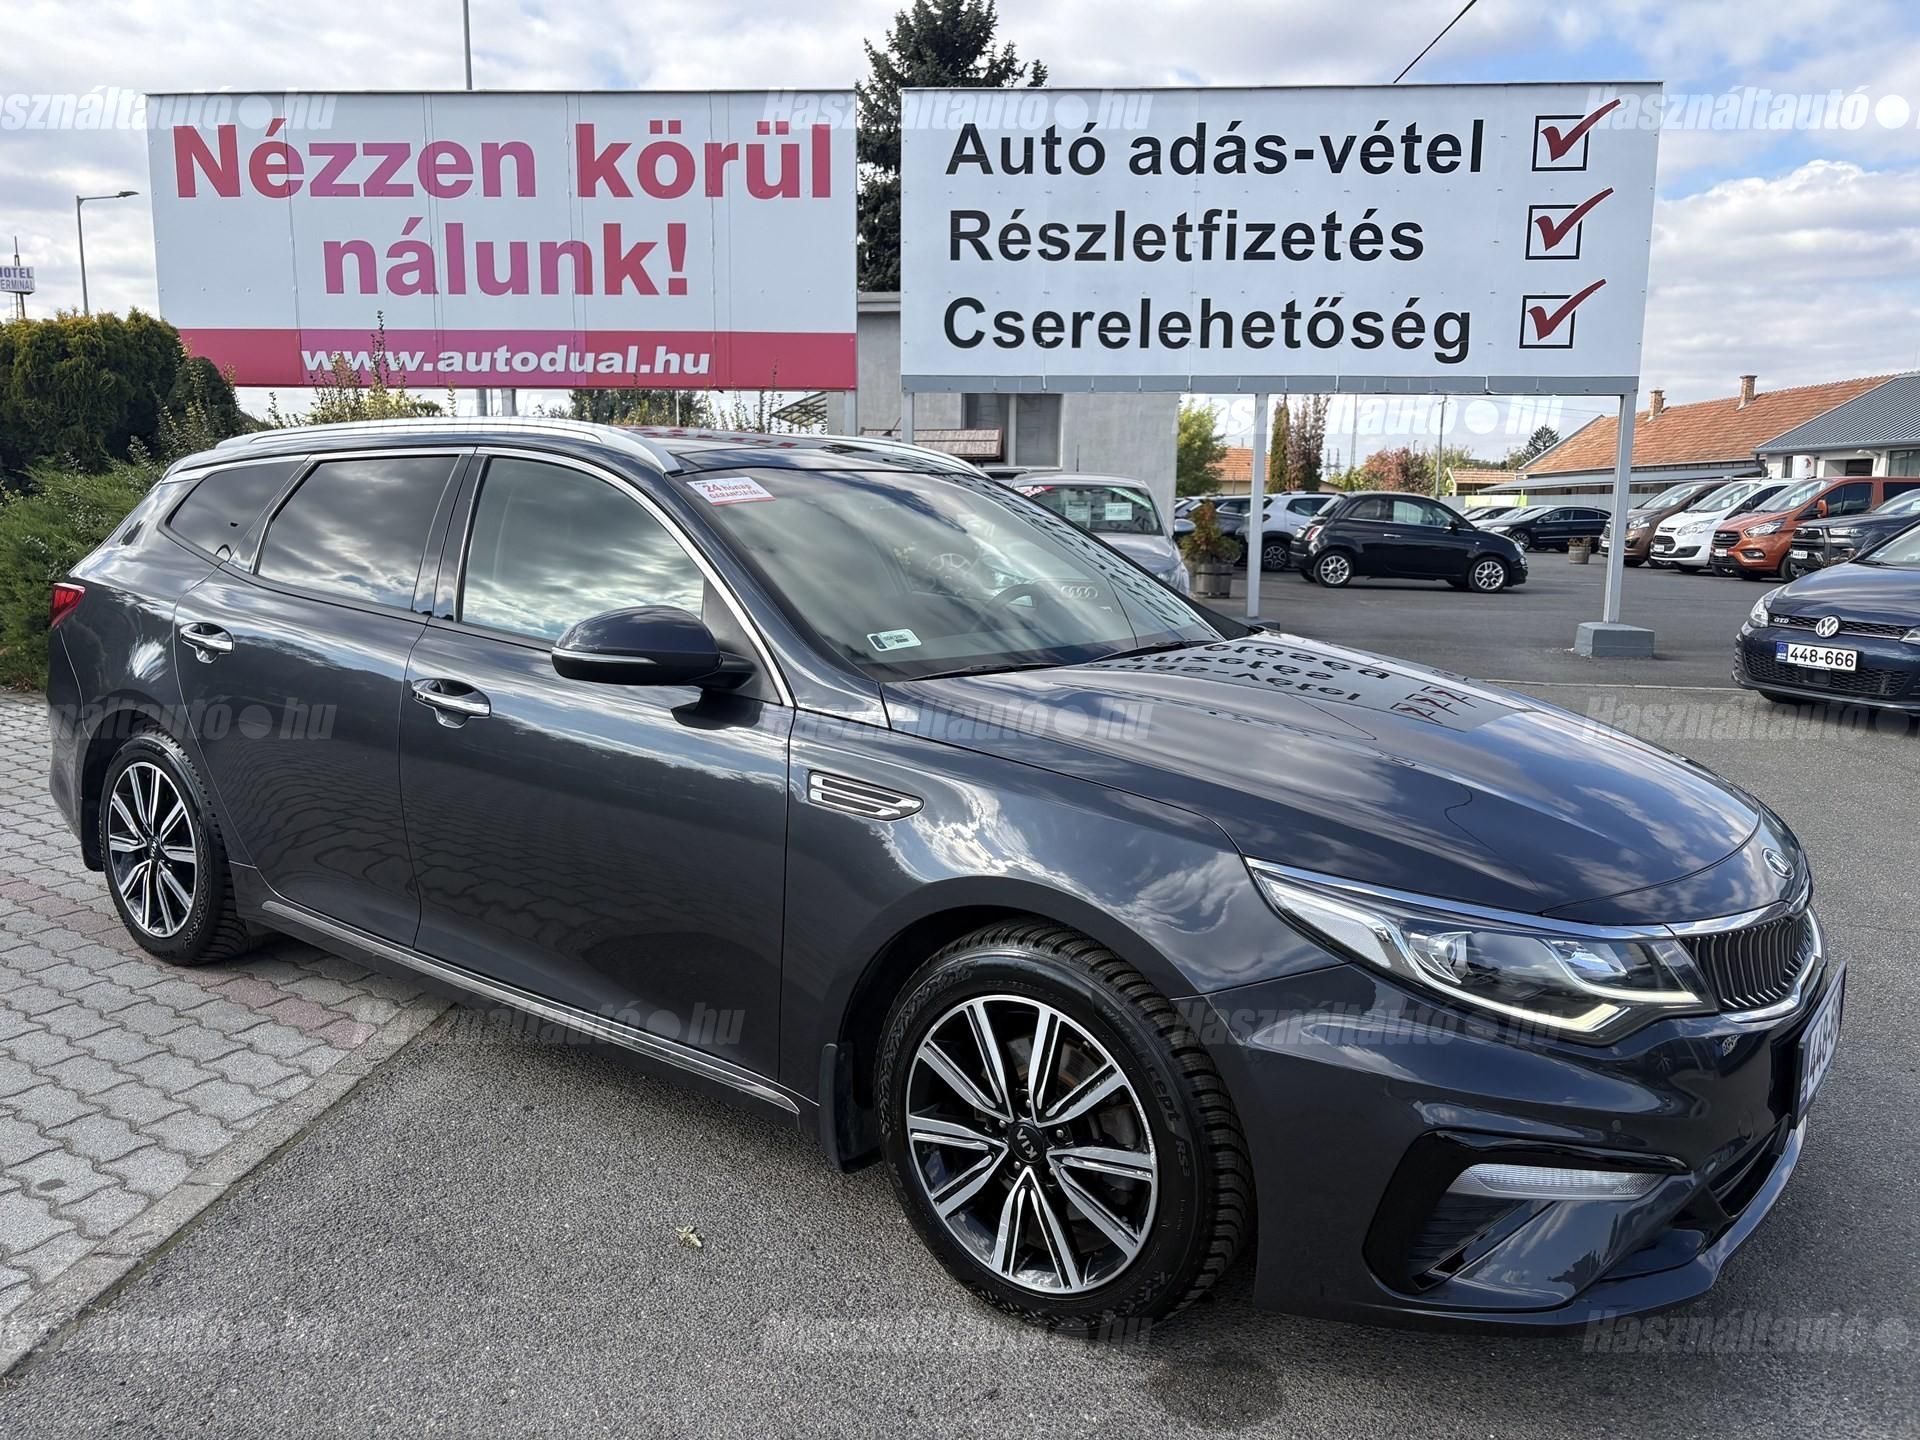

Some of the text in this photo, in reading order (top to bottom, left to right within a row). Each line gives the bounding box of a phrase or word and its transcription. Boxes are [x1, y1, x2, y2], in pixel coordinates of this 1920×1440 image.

[174, 118, 831, 199] Nézzen körül
[946, 118, 1485, 176] Autó adás-vétel
[324, 216, 688, 296] nálunk!
[949, 209, 1425, 262] Részletfizetés
[944, 294, 1472, 364] Cserelehetőség
[302, 344, 710, 377] www.autodual.hu
[1789, 647, 1855, 668] 448-666
[1016, 1127, 1038, 1159] KIA
